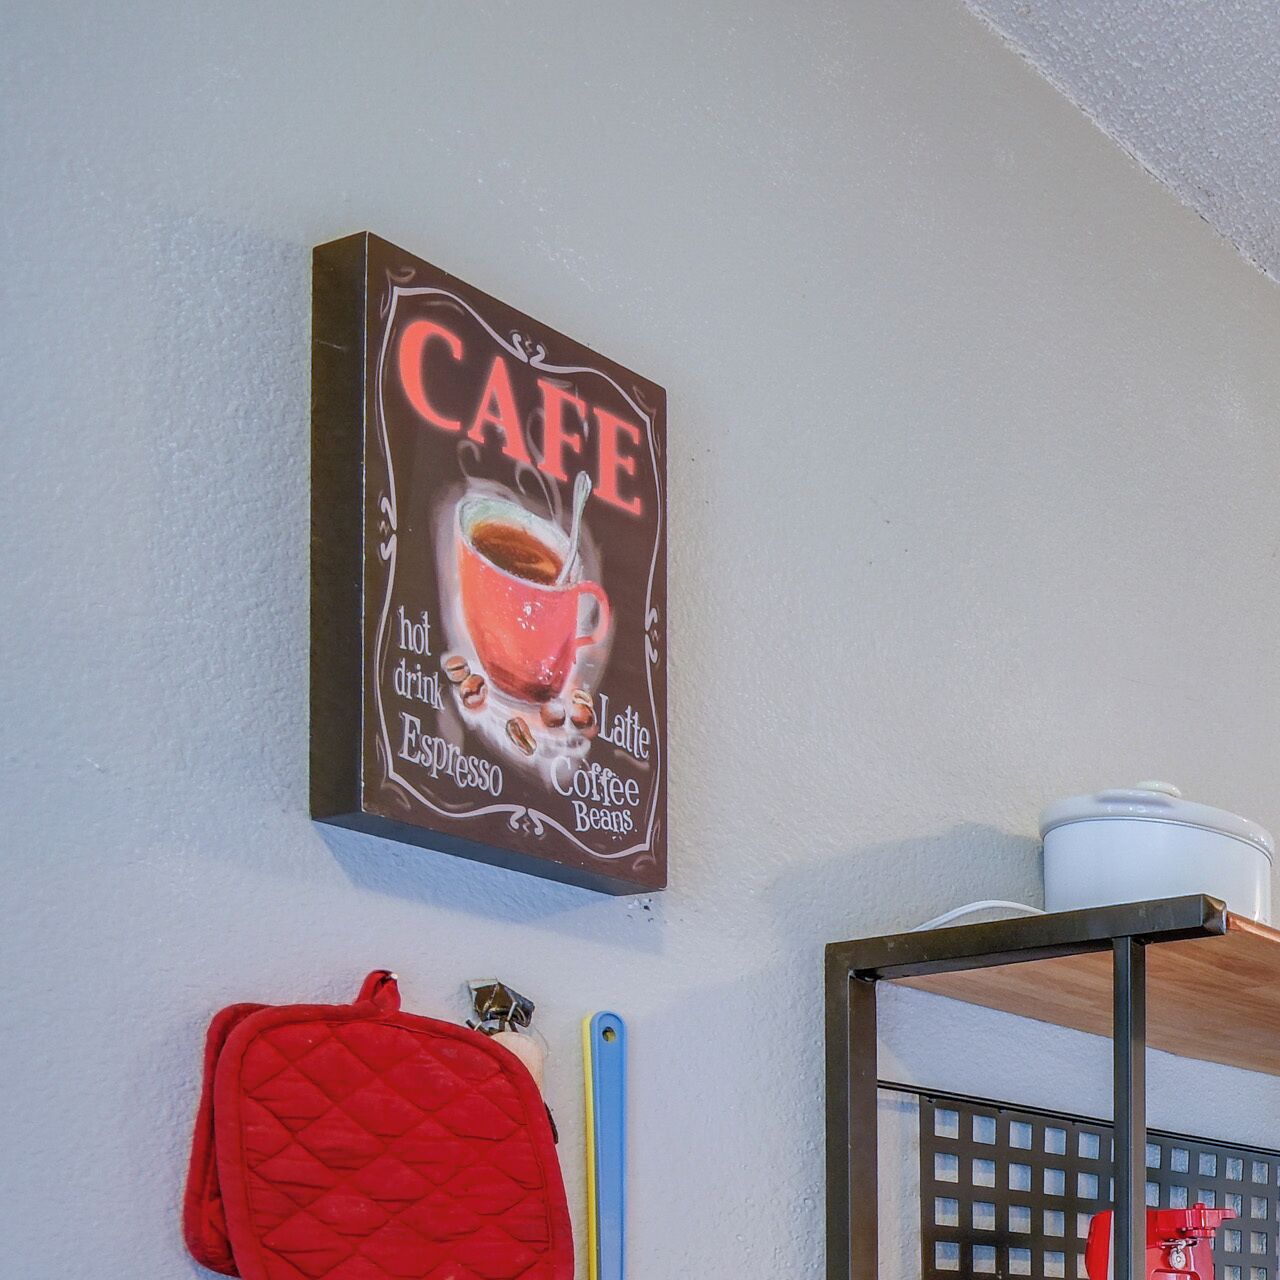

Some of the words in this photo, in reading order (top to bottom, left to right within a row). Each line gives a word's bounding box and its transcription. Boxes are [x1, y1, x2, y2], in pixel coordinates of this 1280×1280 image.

[399, 319, 642, 516] CAFE
[398, 605, 432, 656] hot
[394, 658, 445, 711] drink
[398, 712, 504, 796] Espresso
[598, 694, 650, 759] Latte
[550, 756, 640, 806] Coffee
